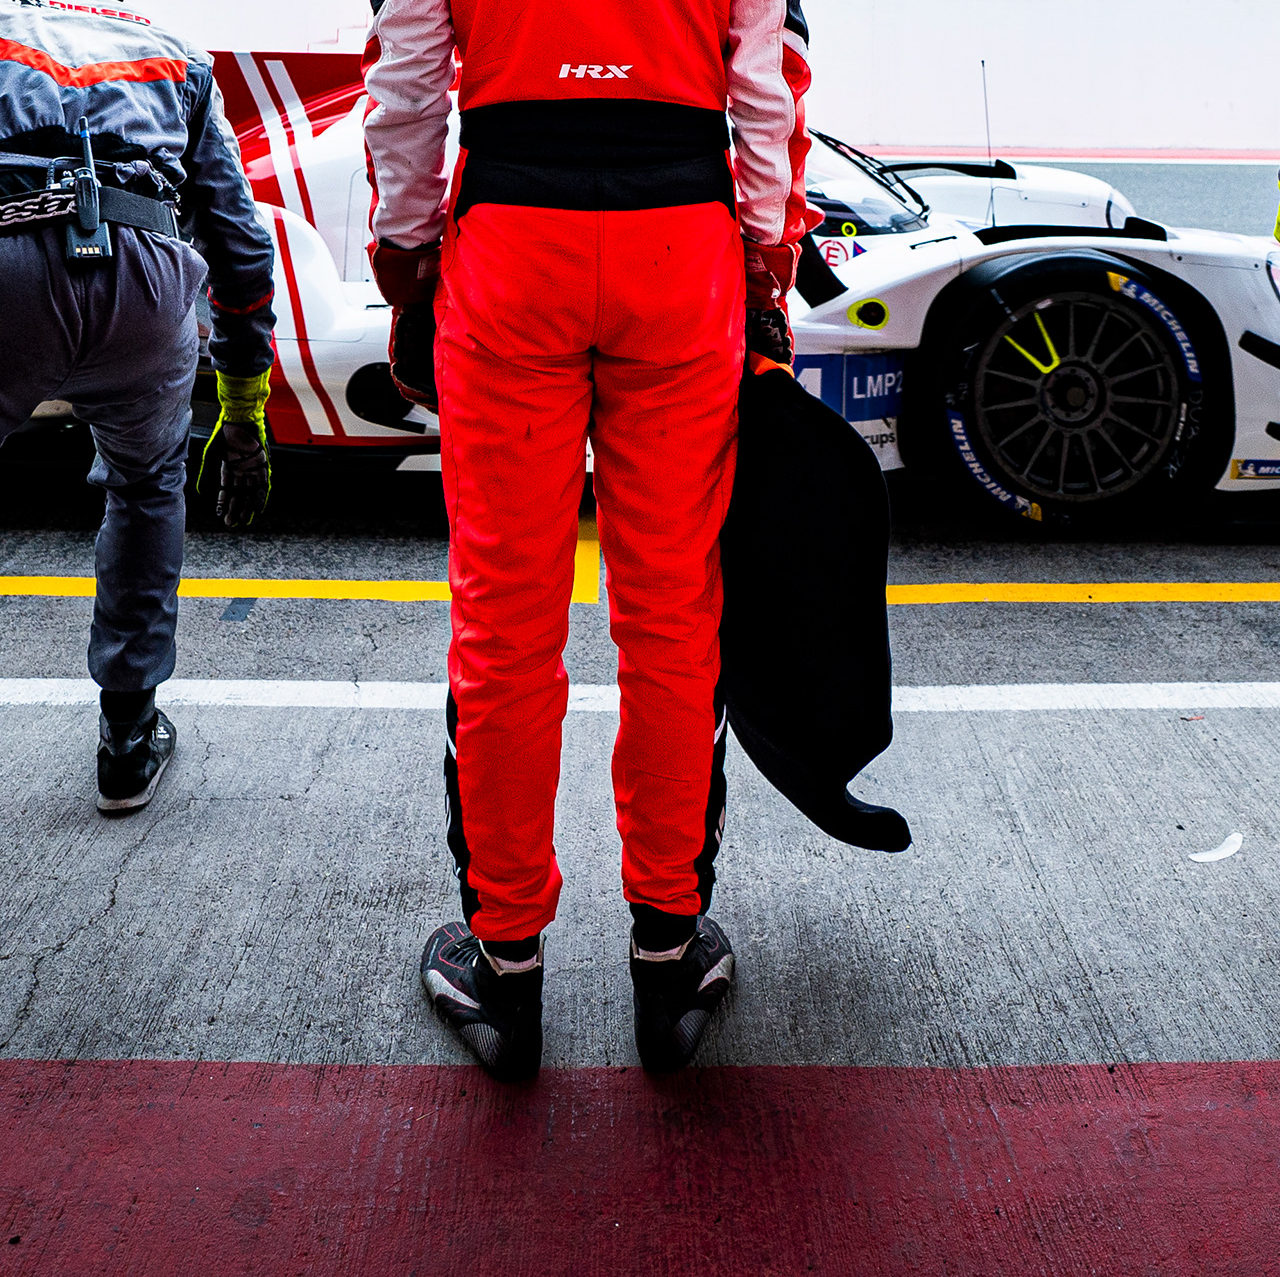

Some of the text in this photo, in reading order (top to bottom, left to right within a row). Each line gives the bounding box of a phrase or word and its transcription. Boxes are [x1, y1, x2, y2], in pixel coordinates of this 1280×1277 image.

[48, 0, 152, 26] NIELSEN
[558, 63, 634, 79] HRX
[1139, 292, 1200, 374] MICHELIN
[852, 371, 904, 399] LMP2
[950, 418, 1012, 503] MICHELIN
